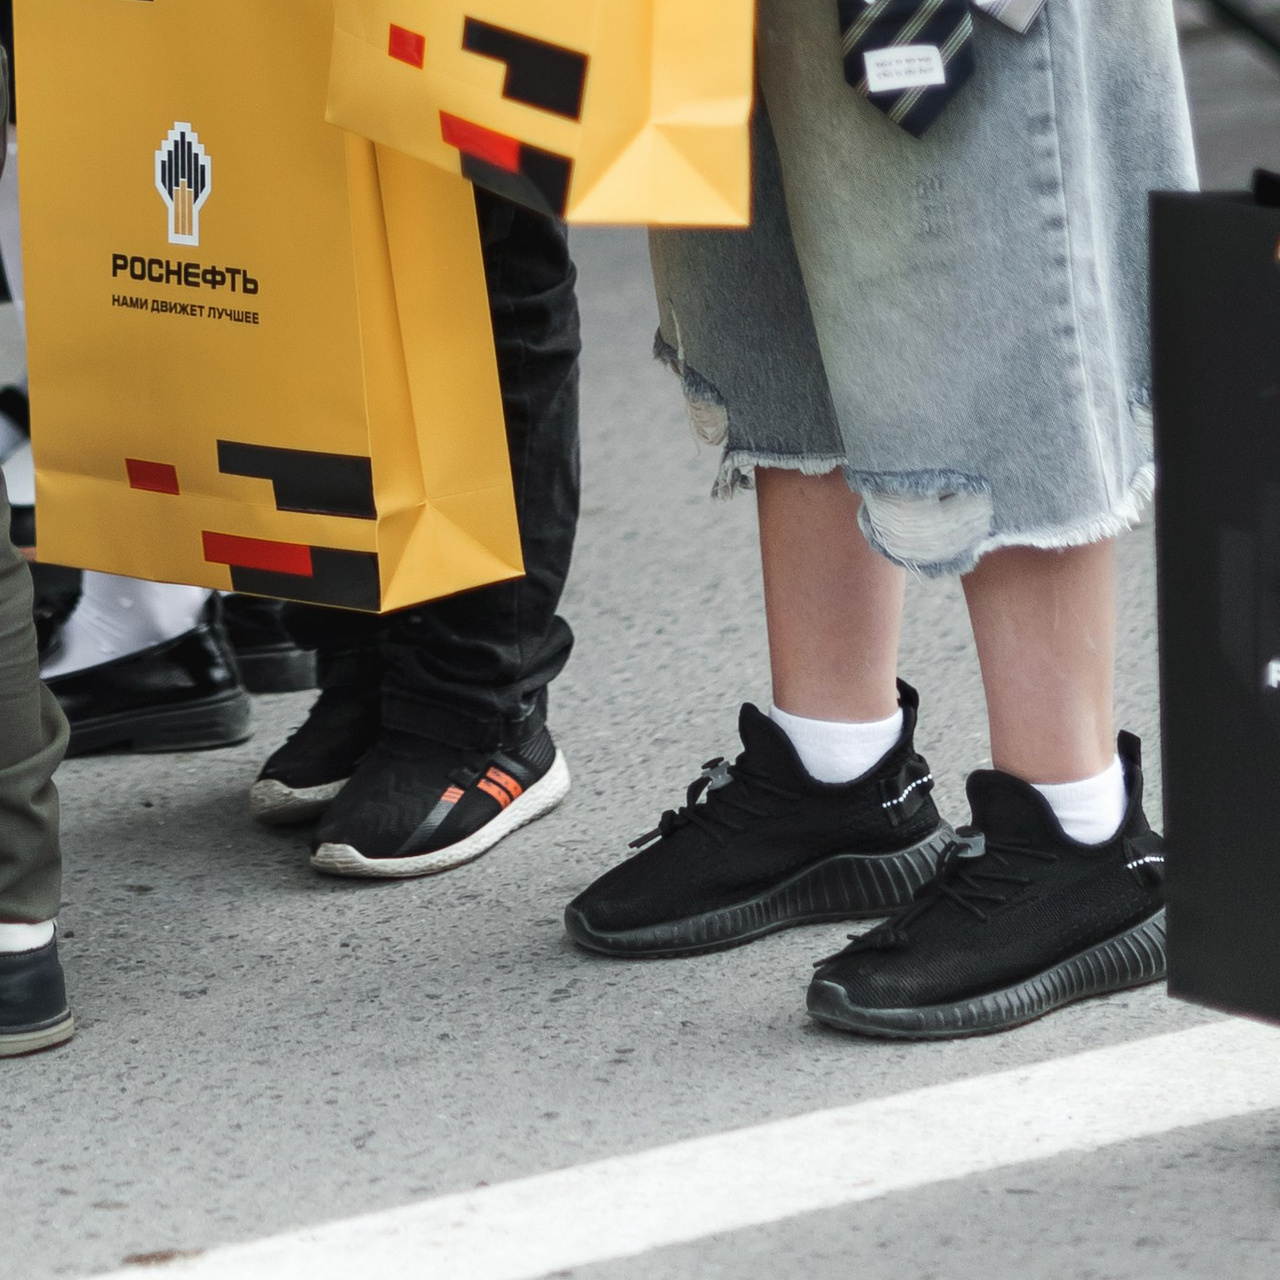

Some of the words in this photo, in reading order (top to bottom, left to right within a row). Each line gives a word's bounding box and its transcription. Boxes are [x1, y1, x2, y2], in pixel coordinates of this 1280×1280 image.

[111, 253, 259, 295] РОСНЕФТЬ
[111, 294, 148, 310] НАМИ
[151, 299, 205, 317] ДВИЖЕТ
[208, 307, 259, 324] ЛУЧШЕЕ
